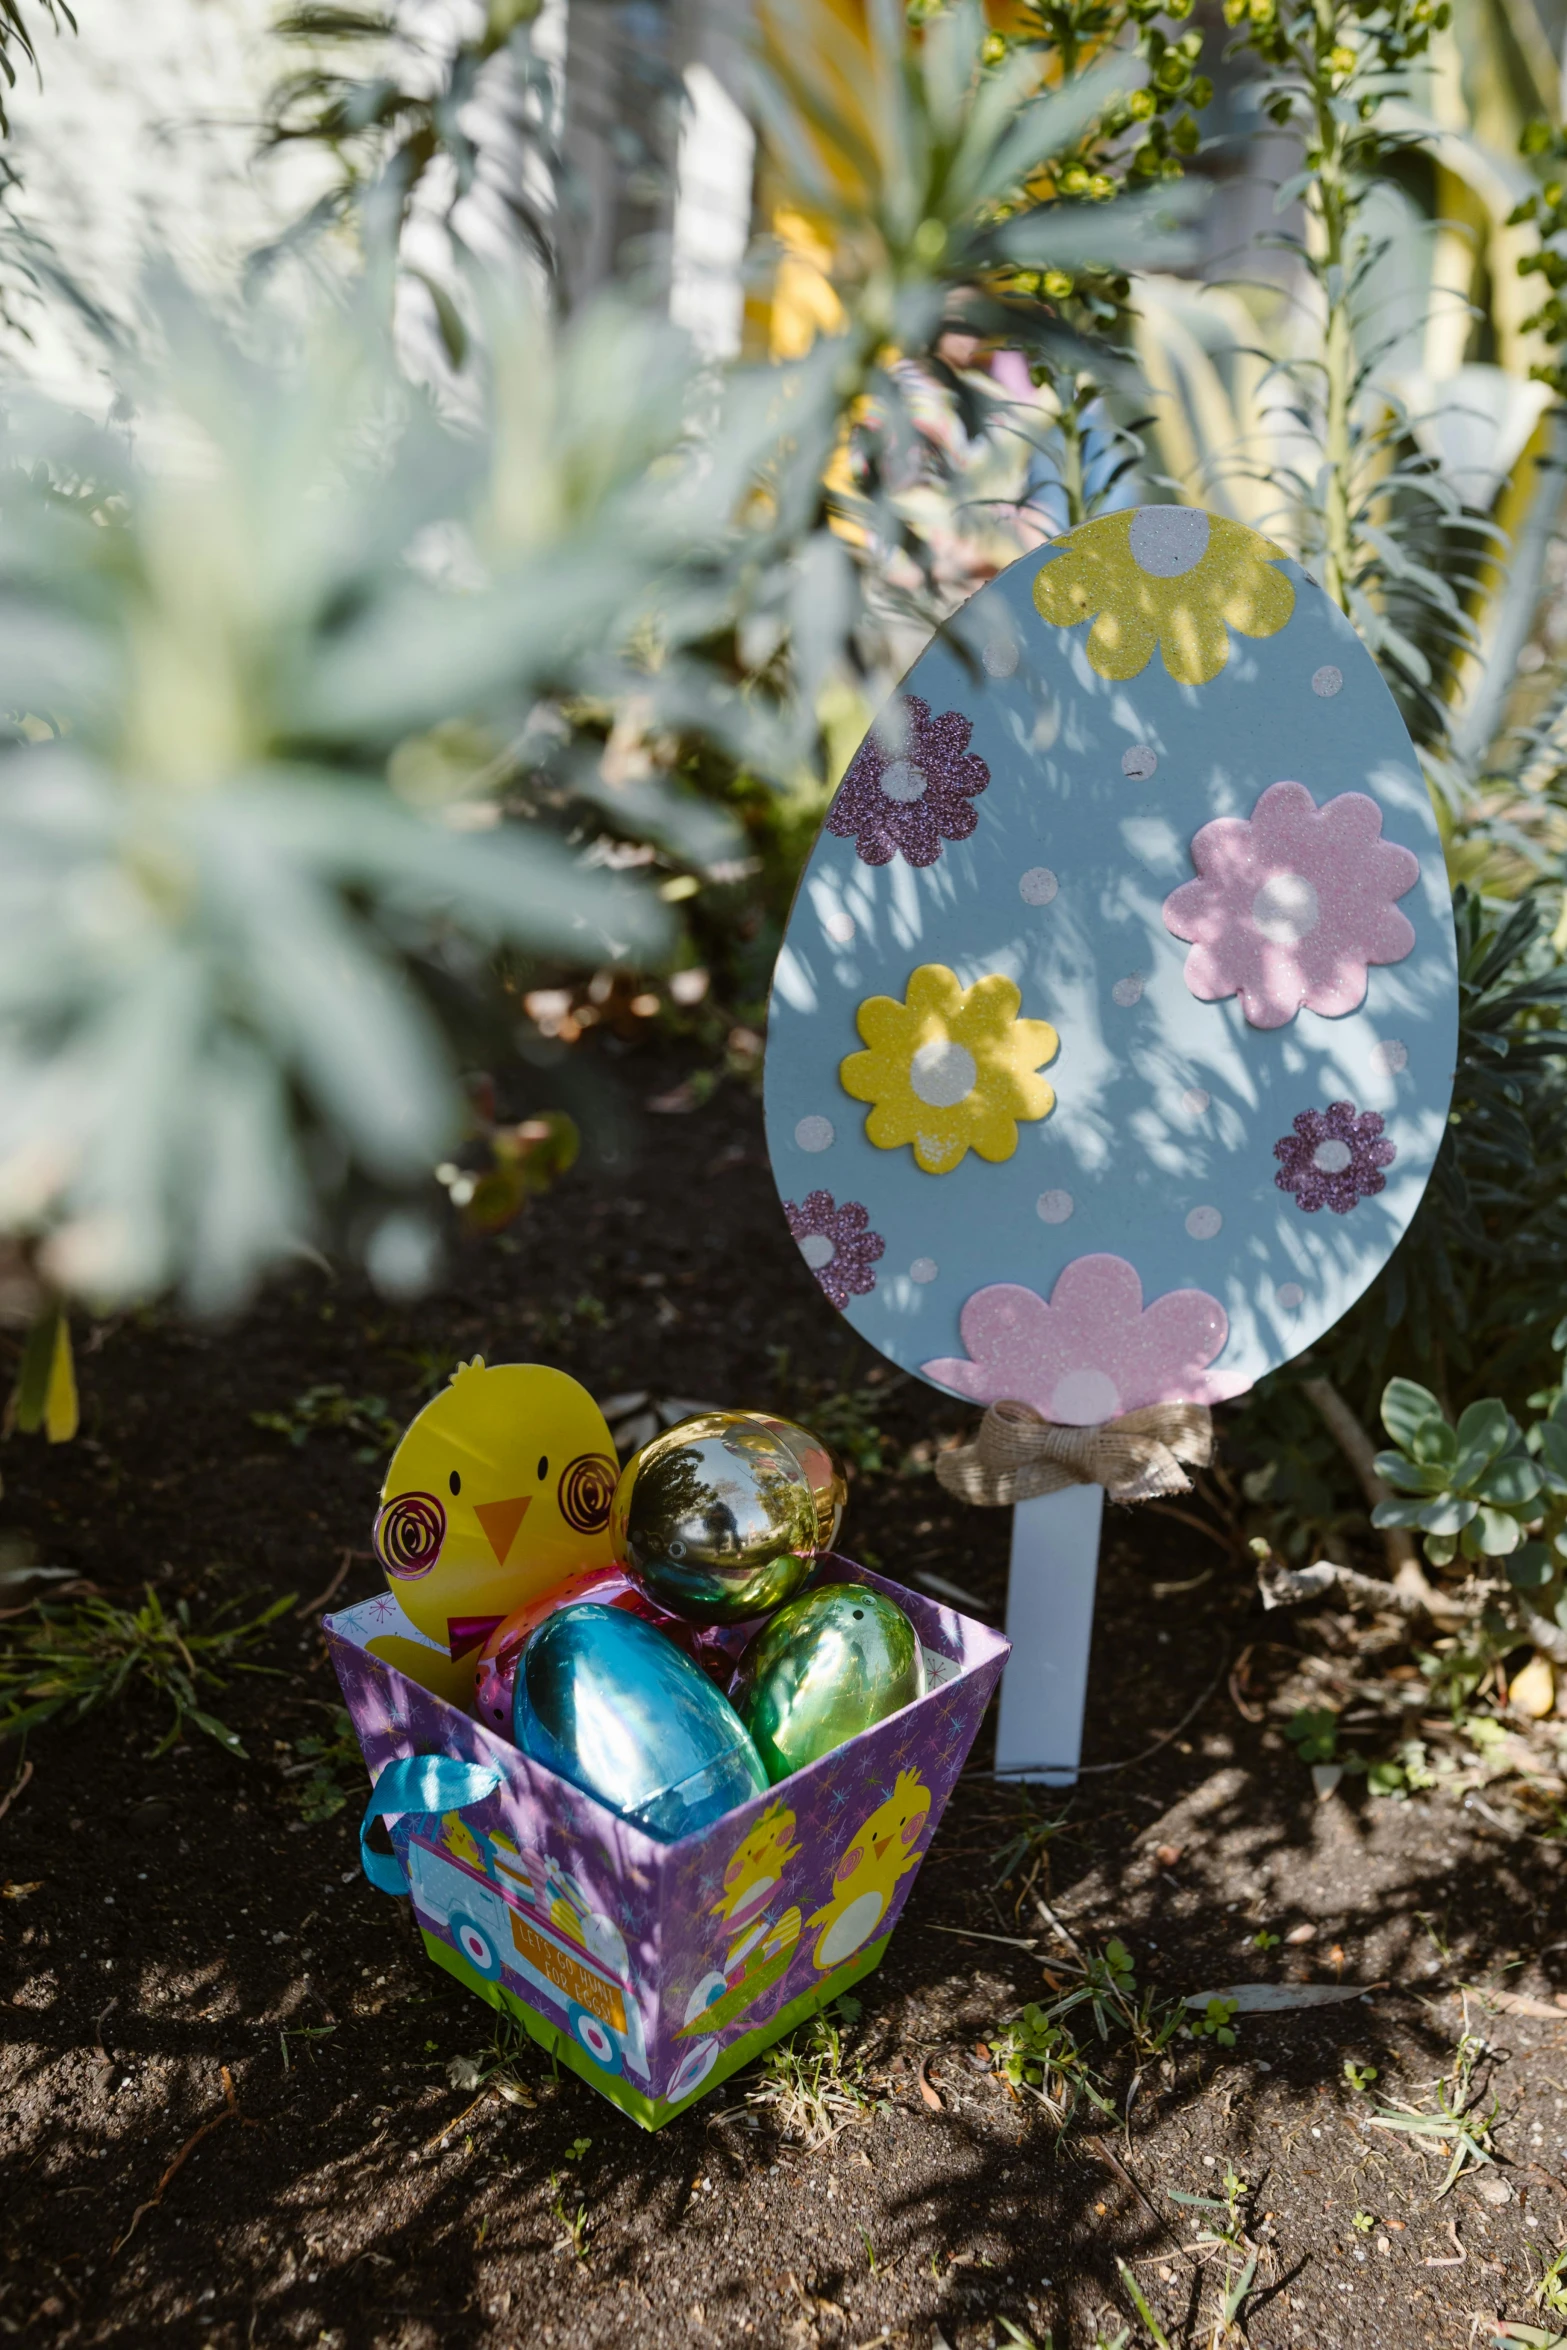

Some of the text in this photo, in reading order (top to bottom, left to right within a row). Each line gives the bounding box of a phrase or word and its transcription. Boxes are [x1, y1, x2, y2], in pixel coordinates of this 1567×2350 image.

[519, 1924, 615, 2005] LET'S GO HUNT
[545, 1961, 611, 2023] FOR EGGS!
